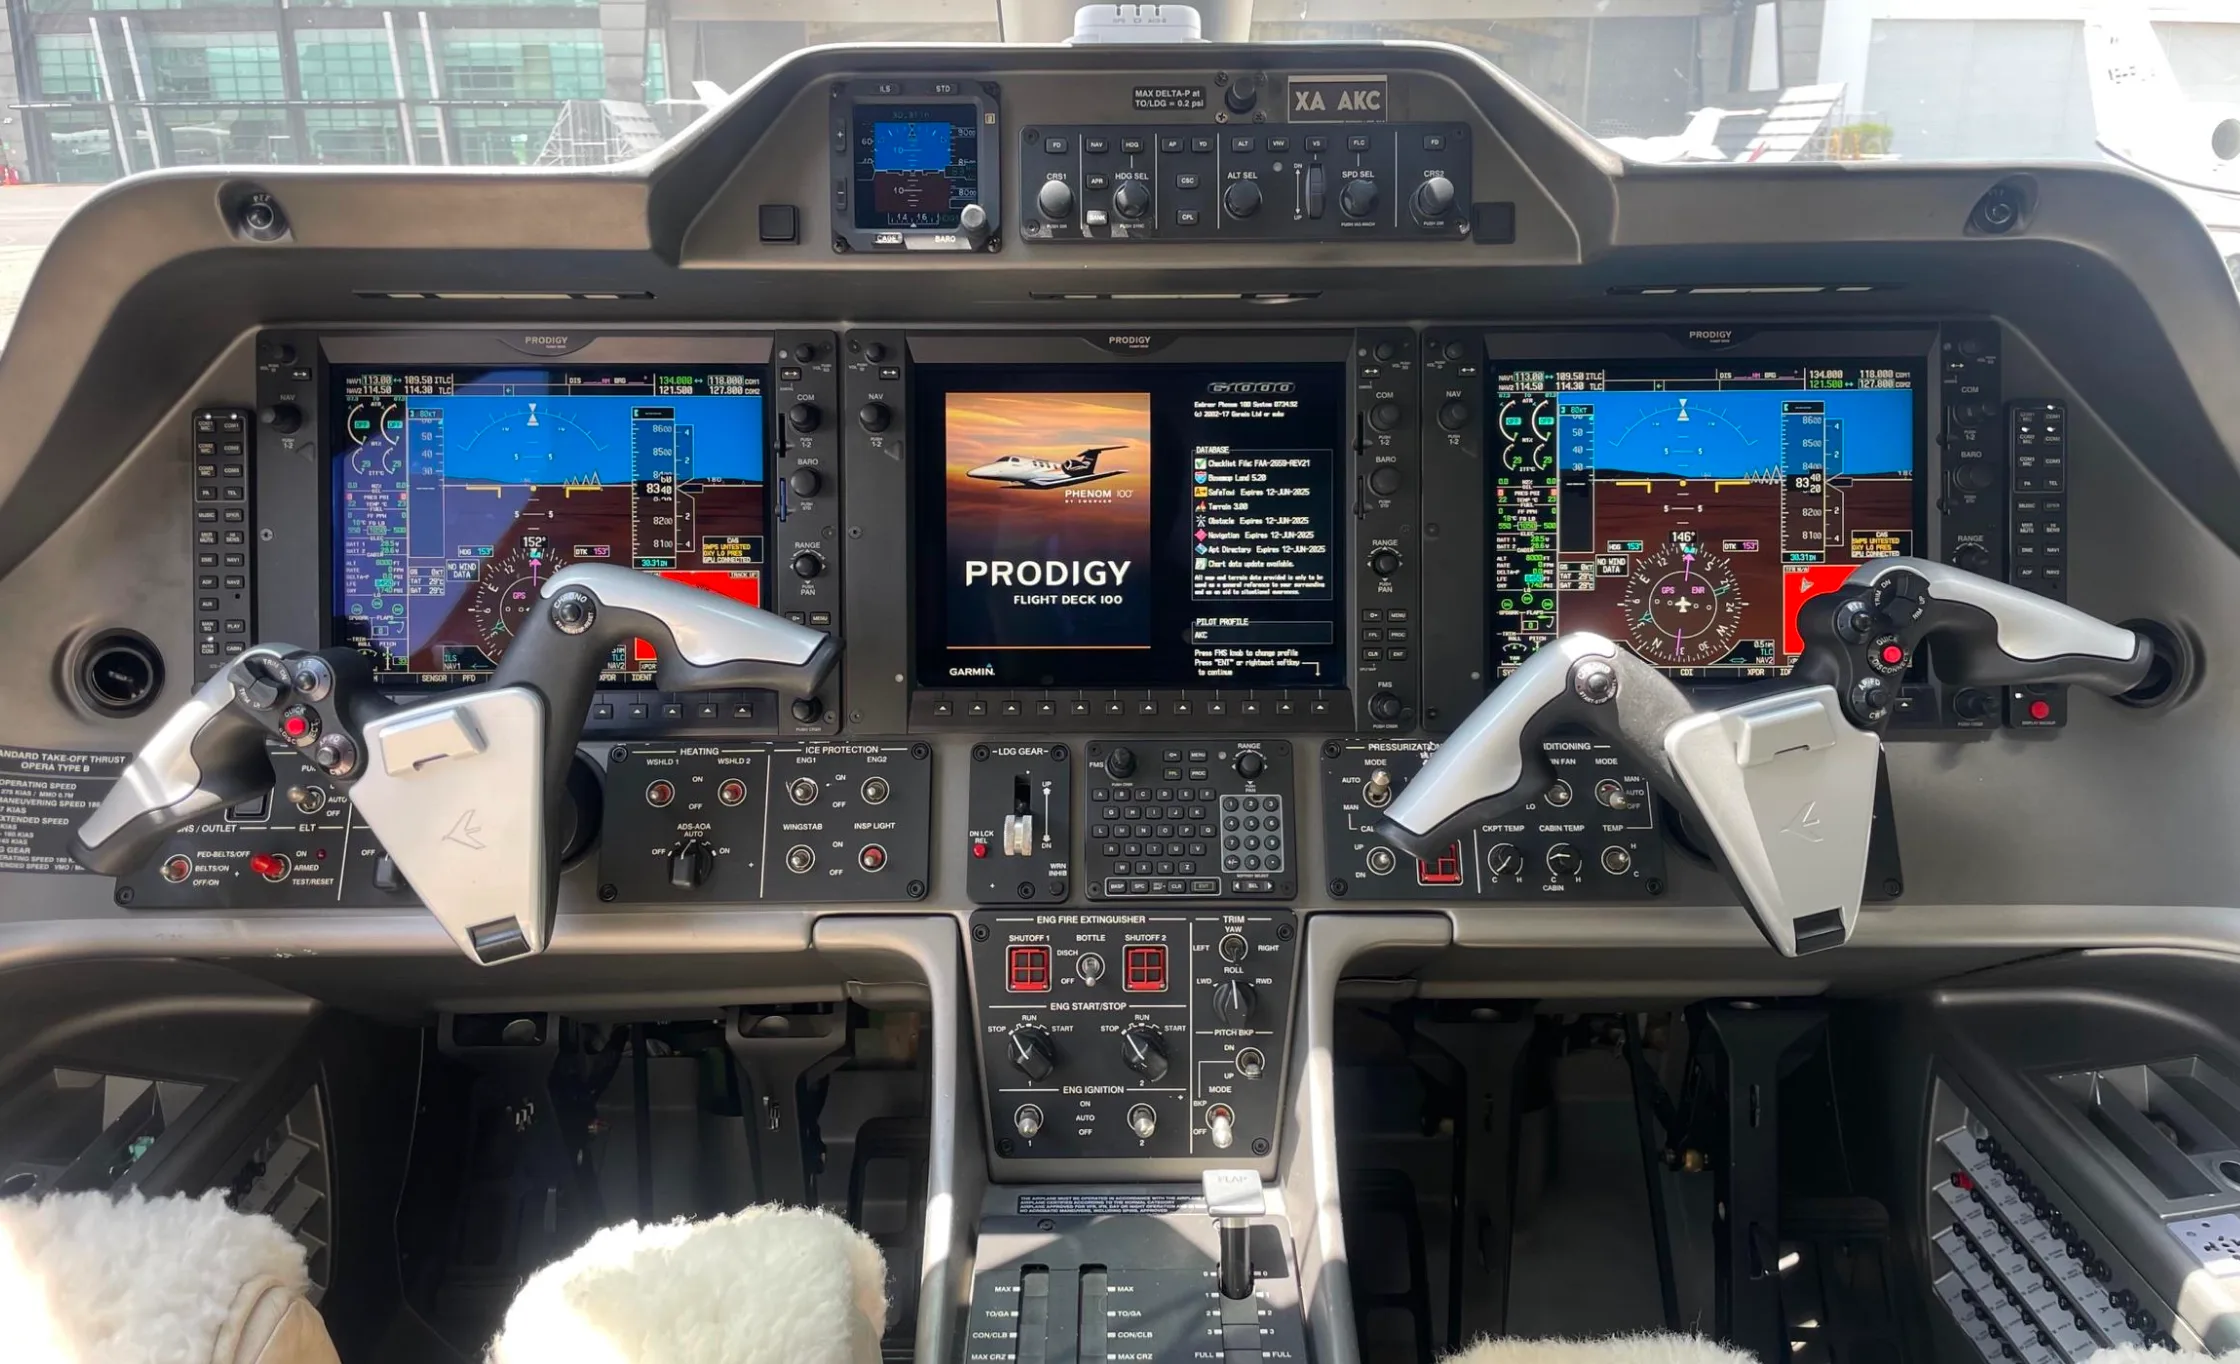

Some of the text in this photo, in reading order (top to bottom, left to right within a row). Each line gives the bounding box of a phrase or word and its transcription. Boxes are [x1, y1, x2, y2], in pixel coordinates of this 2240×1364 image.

[1192, 100, 1203, 109] psi
[1296, 91, 1380, 111] XA AKC
[525, 336, 568, 345] PRODIGY
[364, 376, 451, 384] 113.00 109.50 ITLC
[659, 376, 743, 385] 134.000 118.000
[1515, 373, 1543, 381] 113.00
[364, 386, 391, 394] 114.50
[404, 386, 432, 394] 114.30
[659, 386, 692, 394] 121.500
[1196, 446, 1229, 454] DATABASE
[1065, 490, 1112, 498] PHENOM
[1672, 532, 1695, 542] 146°
[523, 537, 546, 547] 152°
[1222, 546, 1251, 554] Directory
[1208, 560, 1225, 568] Chart
[1597, 558, 1608, 566] NO
[966, 561, 1131, 586] PRODIGY
[554, 593, 587, 609] CHRONO
[1014, 595, 1123, 604] FLIGHT DECK 100
[1196, 618, 1248, 626] PILOT PROFILE
[949, 667, 994, 676] GARMIN
[822, 746, 878, 754] PROTECTION
[42, 753, 88, 762] TAKE-OFF
[21, 762, 54, 771] OPERA
[202, 824, 236, 833] OUTLET
[299, 824, 315, 832] ELT
[1037, 915, 1145, 924] ENG FIRE EXTINGUISHER
